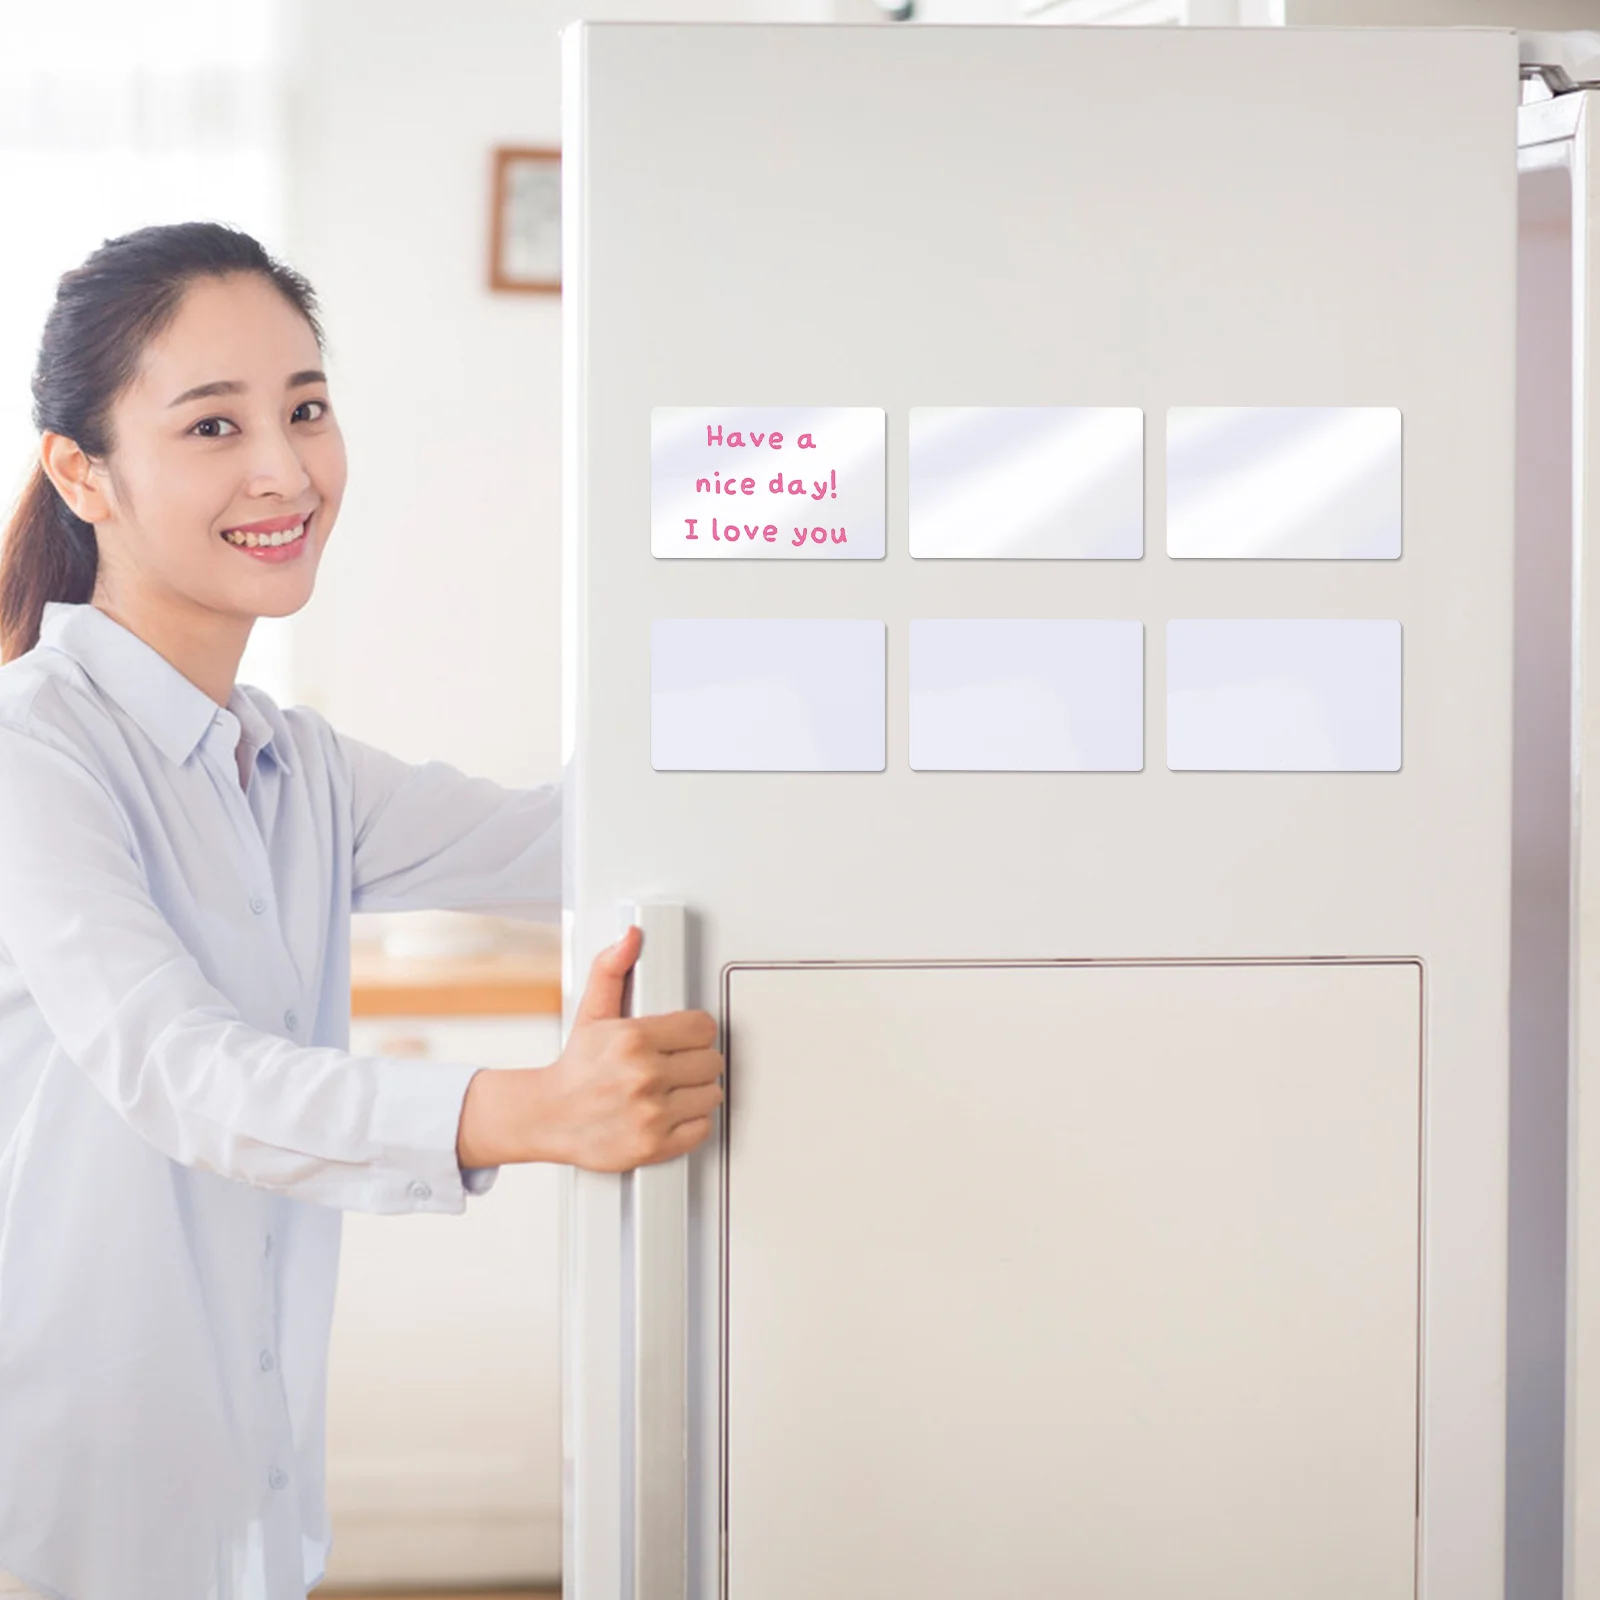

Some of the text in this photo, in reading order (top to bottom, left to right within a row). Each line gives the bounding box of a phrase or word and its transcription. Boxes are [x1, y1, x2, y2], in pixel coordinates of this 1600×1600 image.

[706, 424, 817, 450] Have a
[695, 469, 838, 501] nice day!
[684, 517, 848, 548] I love you
